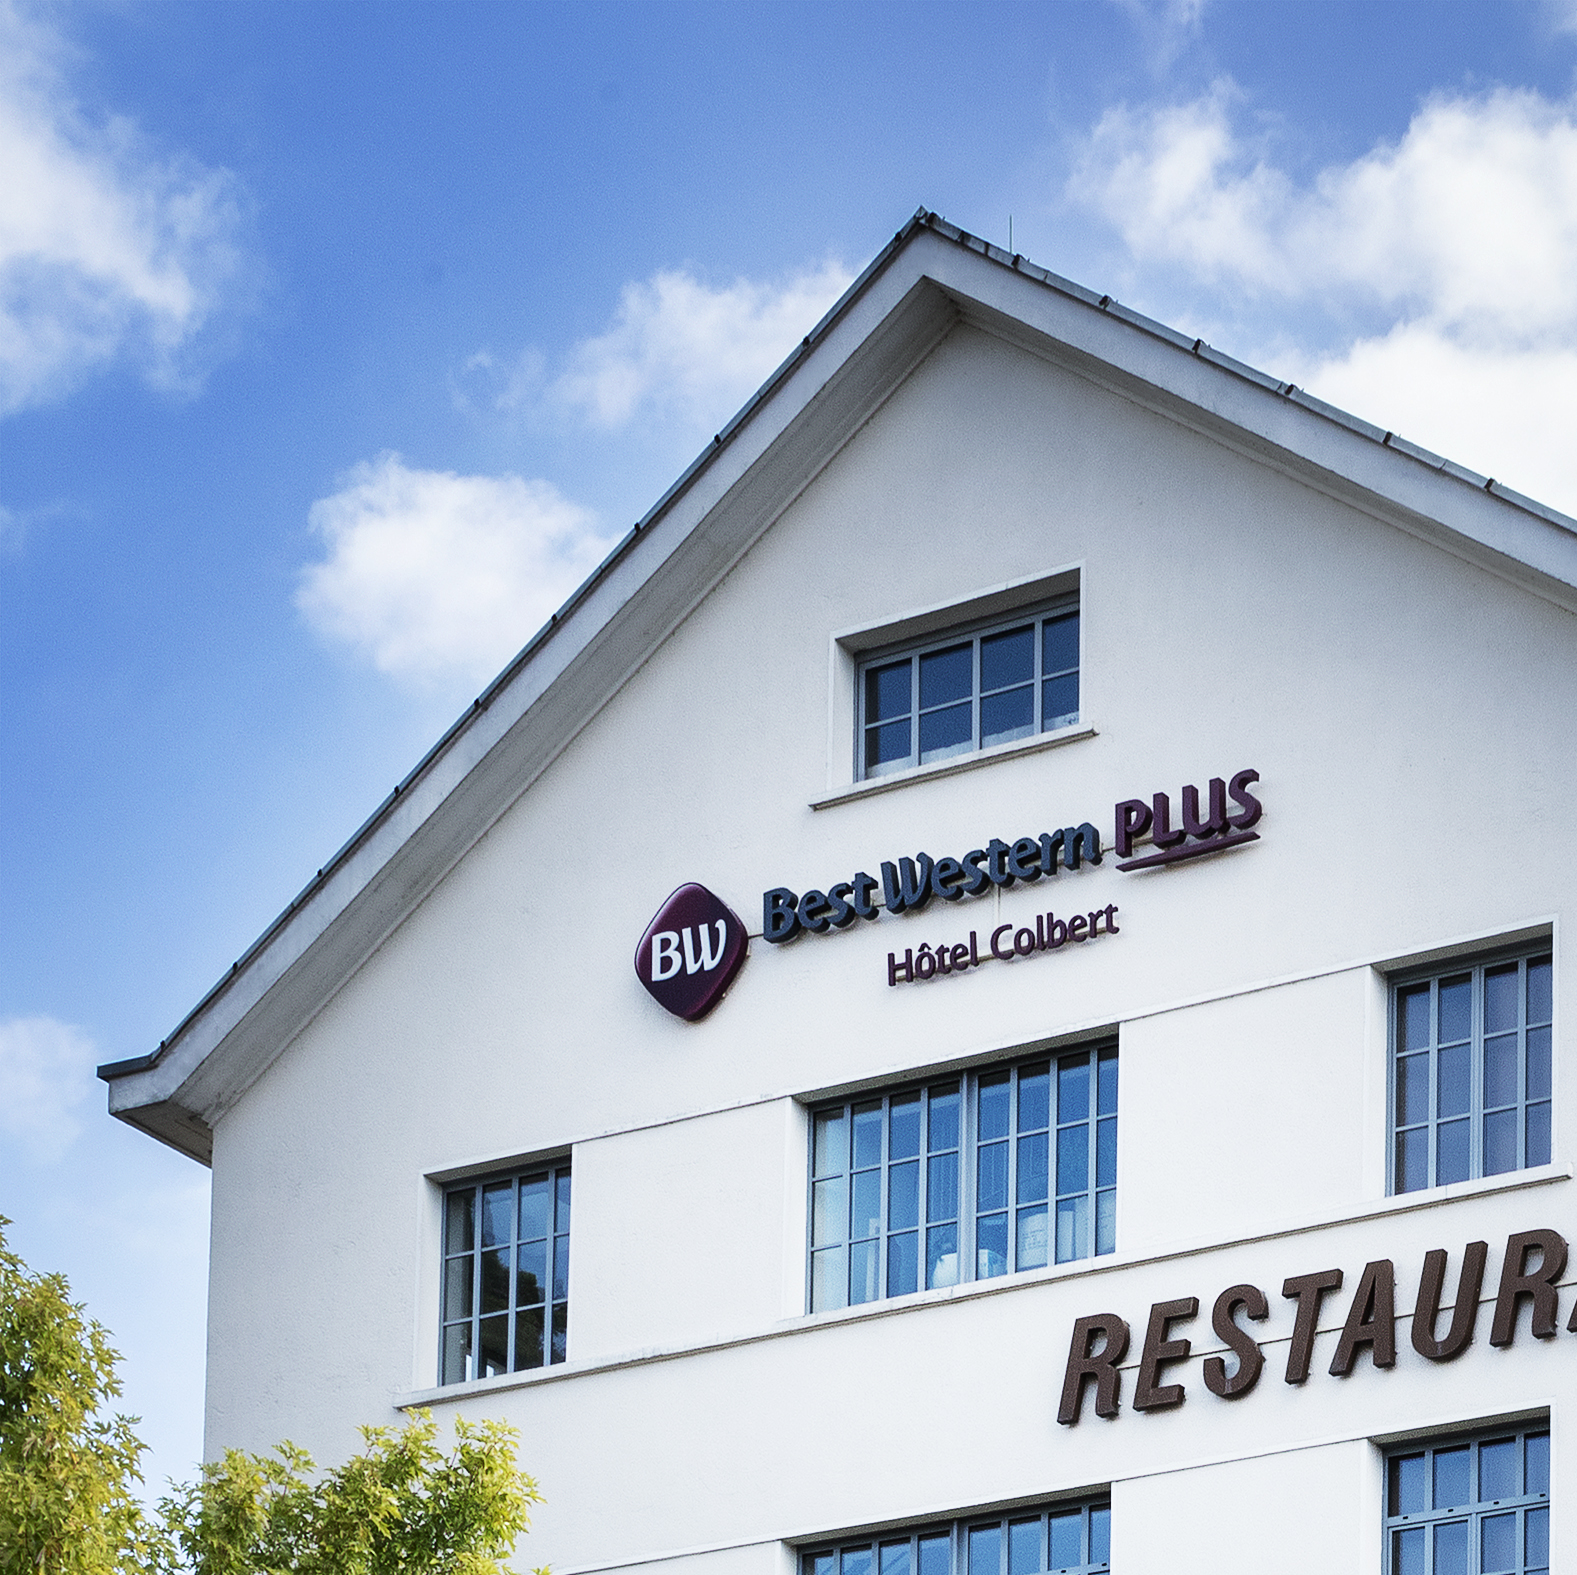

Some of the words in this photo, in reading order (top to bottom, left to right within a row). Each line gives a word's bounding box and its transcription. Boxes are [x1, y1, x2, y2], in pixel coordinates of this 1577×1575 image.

[762, 872, 878, 943] Best
[881, 822, 1102, 916] Western
[1115, 769, 1262, 858] PLUS
[651, 917, 727, 983] BW
[887, 931, 979, 987] Hôtel
[990, 904, 1120, 961] Colbert
